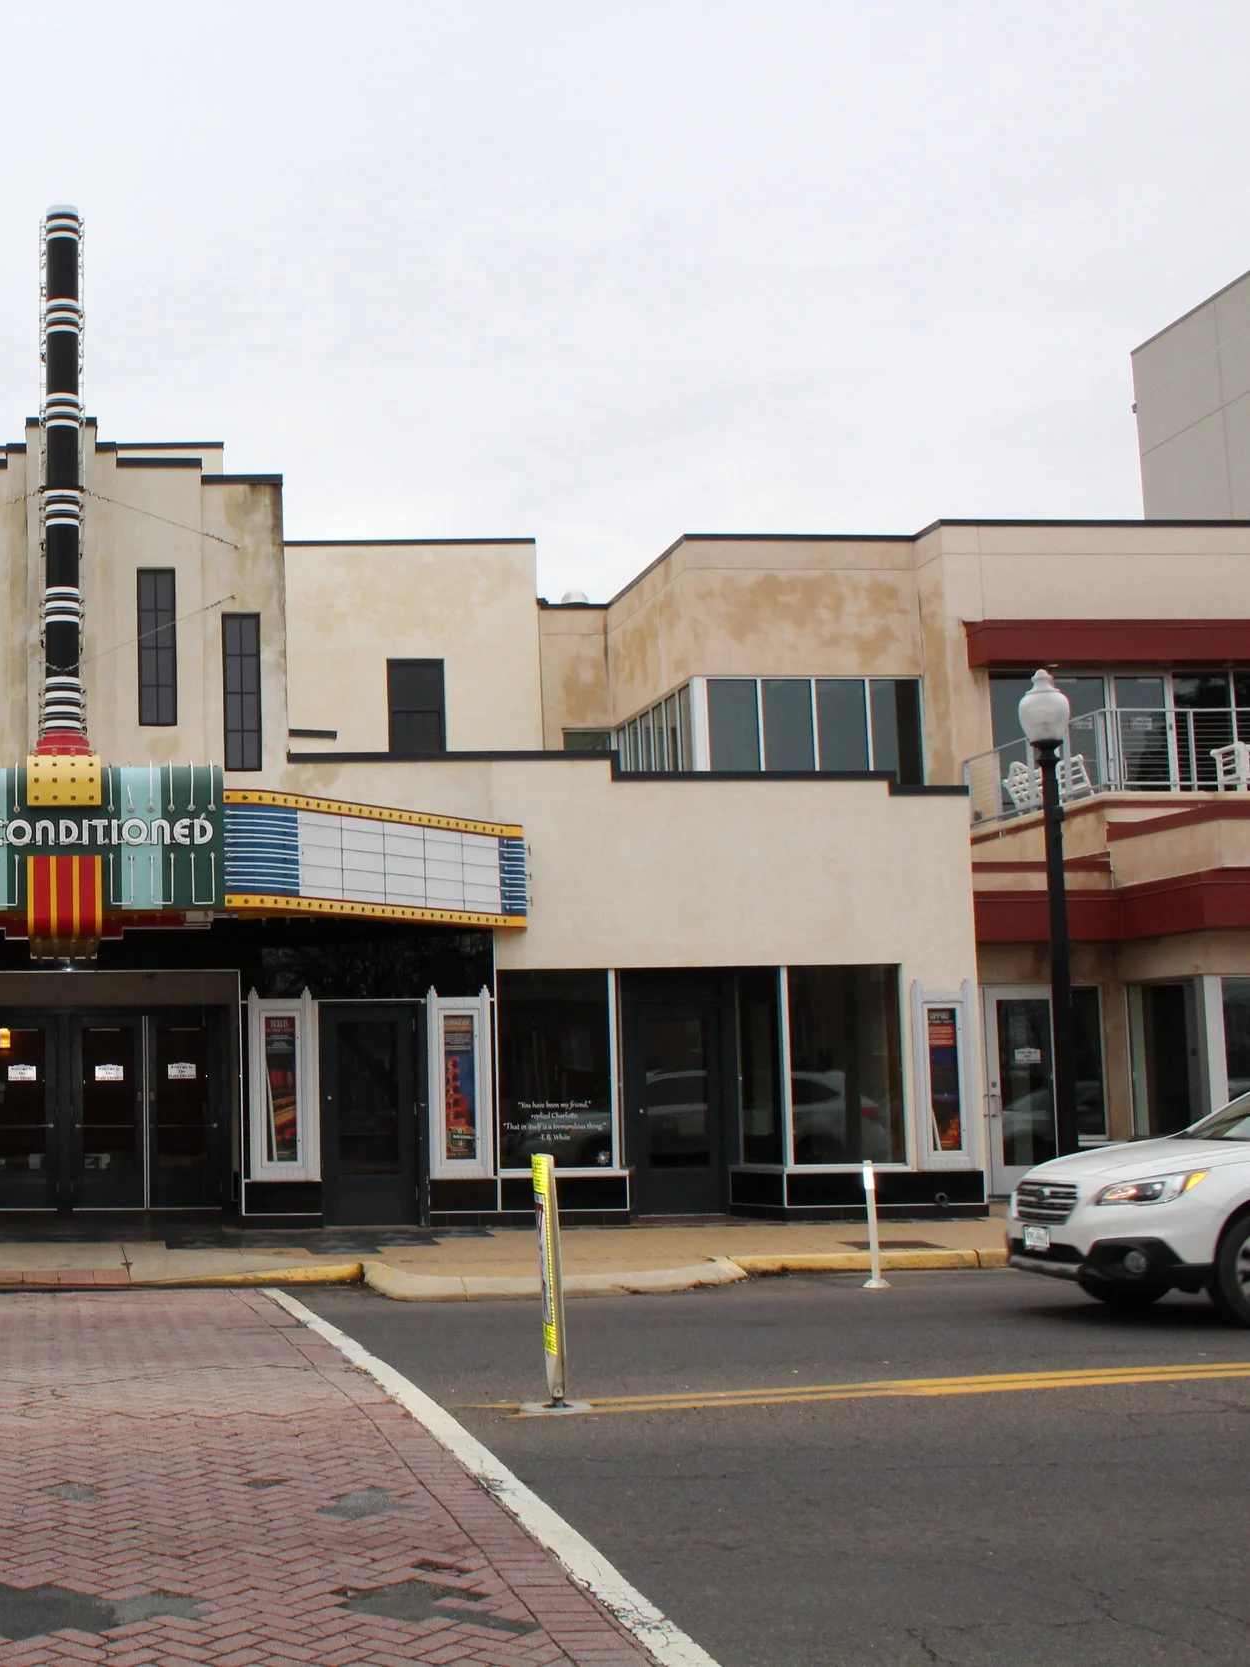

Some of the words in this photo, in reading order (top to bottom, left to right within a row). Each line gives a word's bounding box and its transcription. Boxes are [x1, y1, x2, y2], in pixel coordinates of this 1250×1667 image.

[532, 1101, 545, 1109] have
[546, 1101, 559, 1109] been
[531, 1111, 550, 1120] replied
[528, 1122, 542, 1131] itself
[553, 1122, 586, 1130] tremendous
[553, 1133, 570, 1141] White
